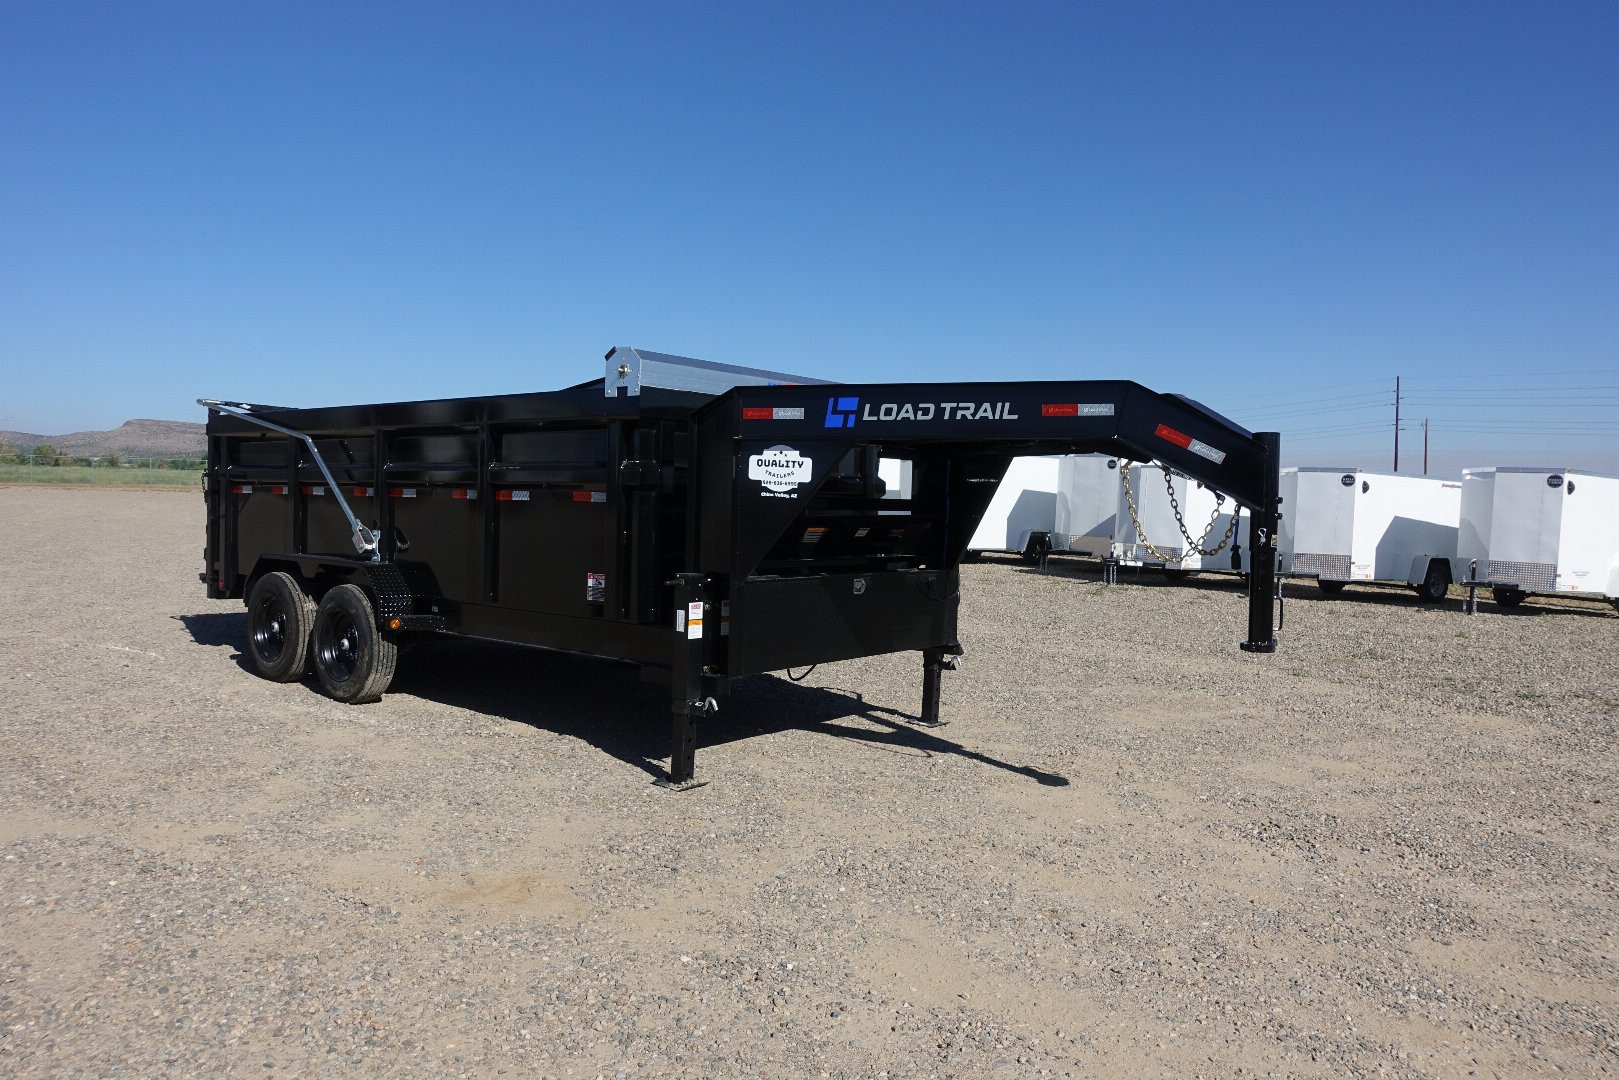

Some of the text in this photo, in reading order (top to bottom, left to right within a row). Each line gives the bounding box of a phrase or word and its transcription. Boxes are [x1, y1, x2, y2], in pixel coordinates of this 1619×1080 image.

[862, 402, 1019, 421] LOAD TRAIL
[756, 458, 804, 468] QUALITY
[765, 470, 795, 478] TRAILERS
